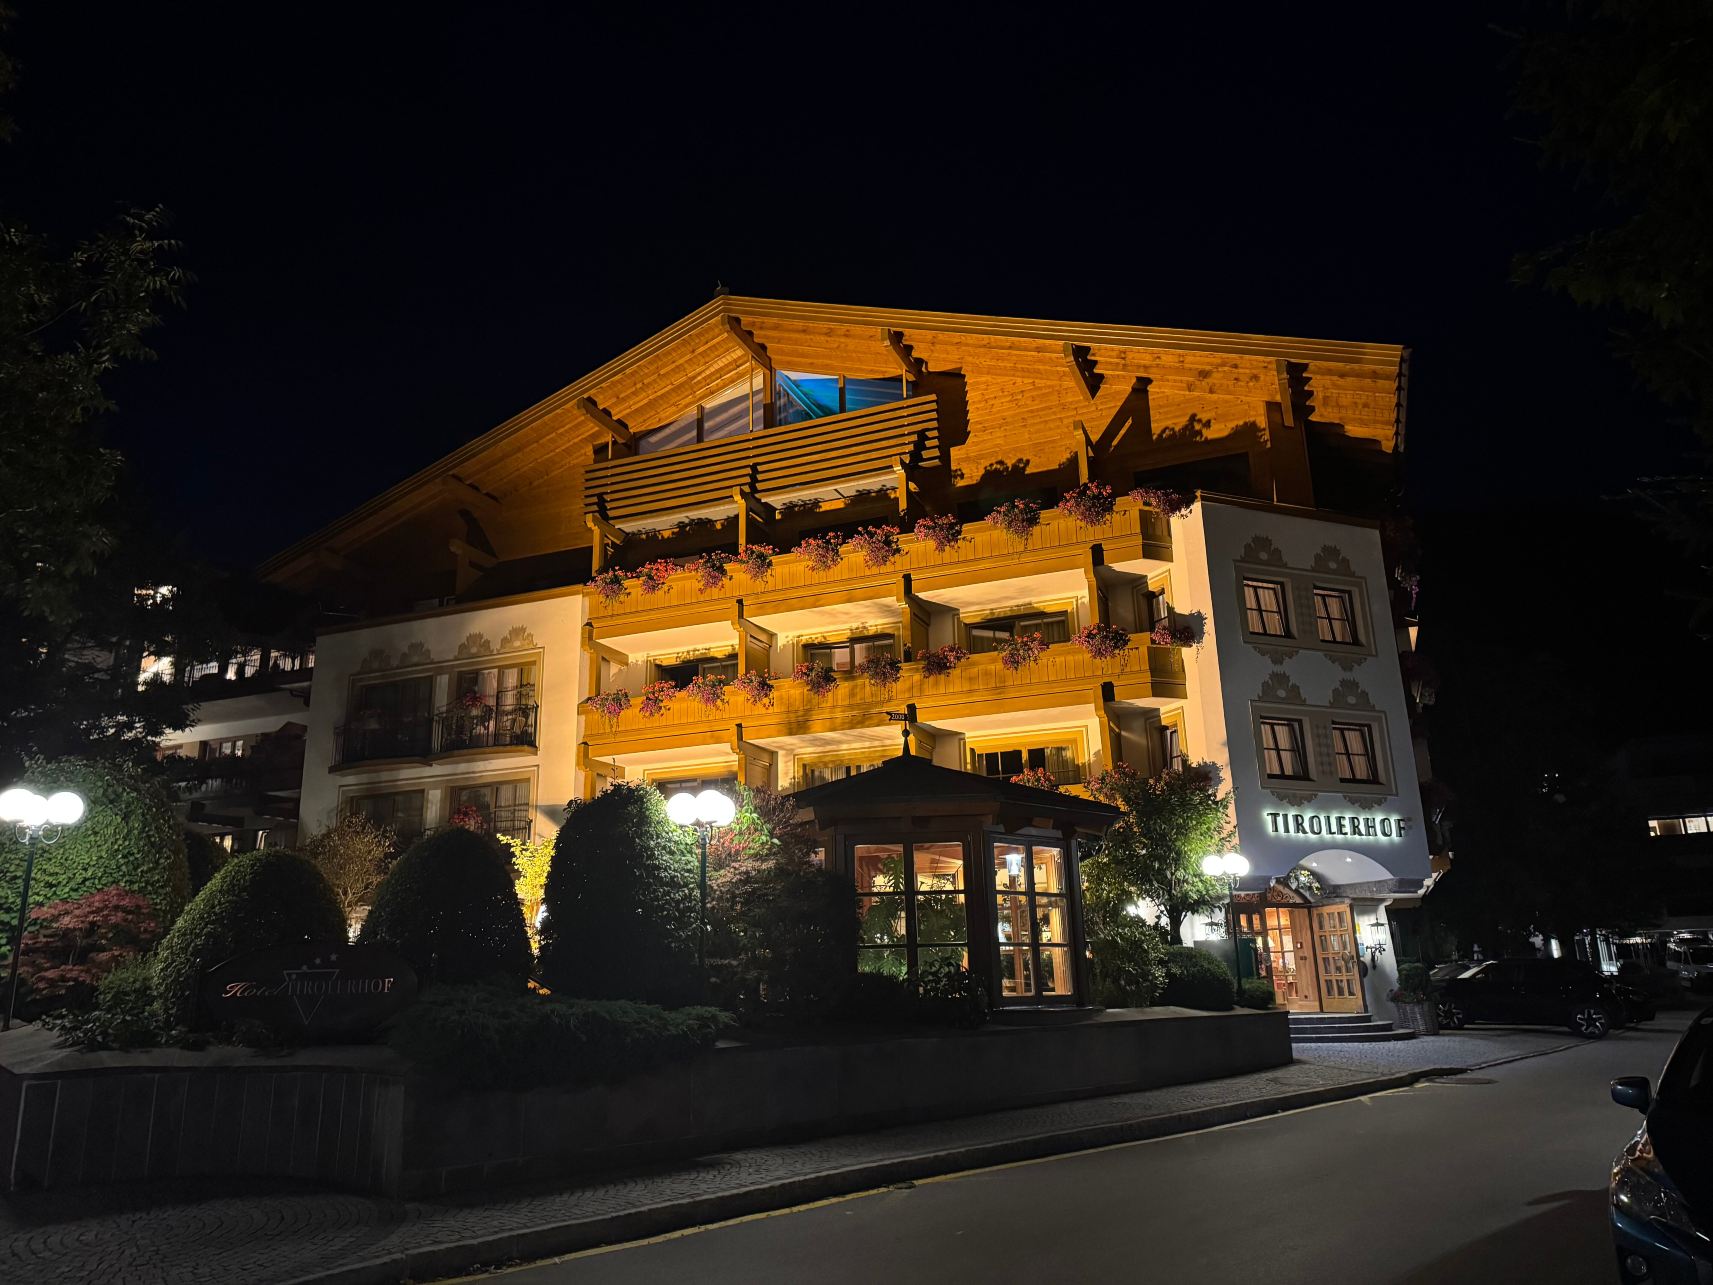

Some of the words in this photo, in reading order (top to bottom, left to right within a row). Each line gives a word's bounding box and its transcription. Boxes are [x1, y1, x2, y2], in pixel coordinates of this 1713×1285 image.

[1267, 812, 1406, 838] TIROLERHOF
[222, 978, 289, 998] Hotel
[287, 977, 394, 996] TIROLERHOF
